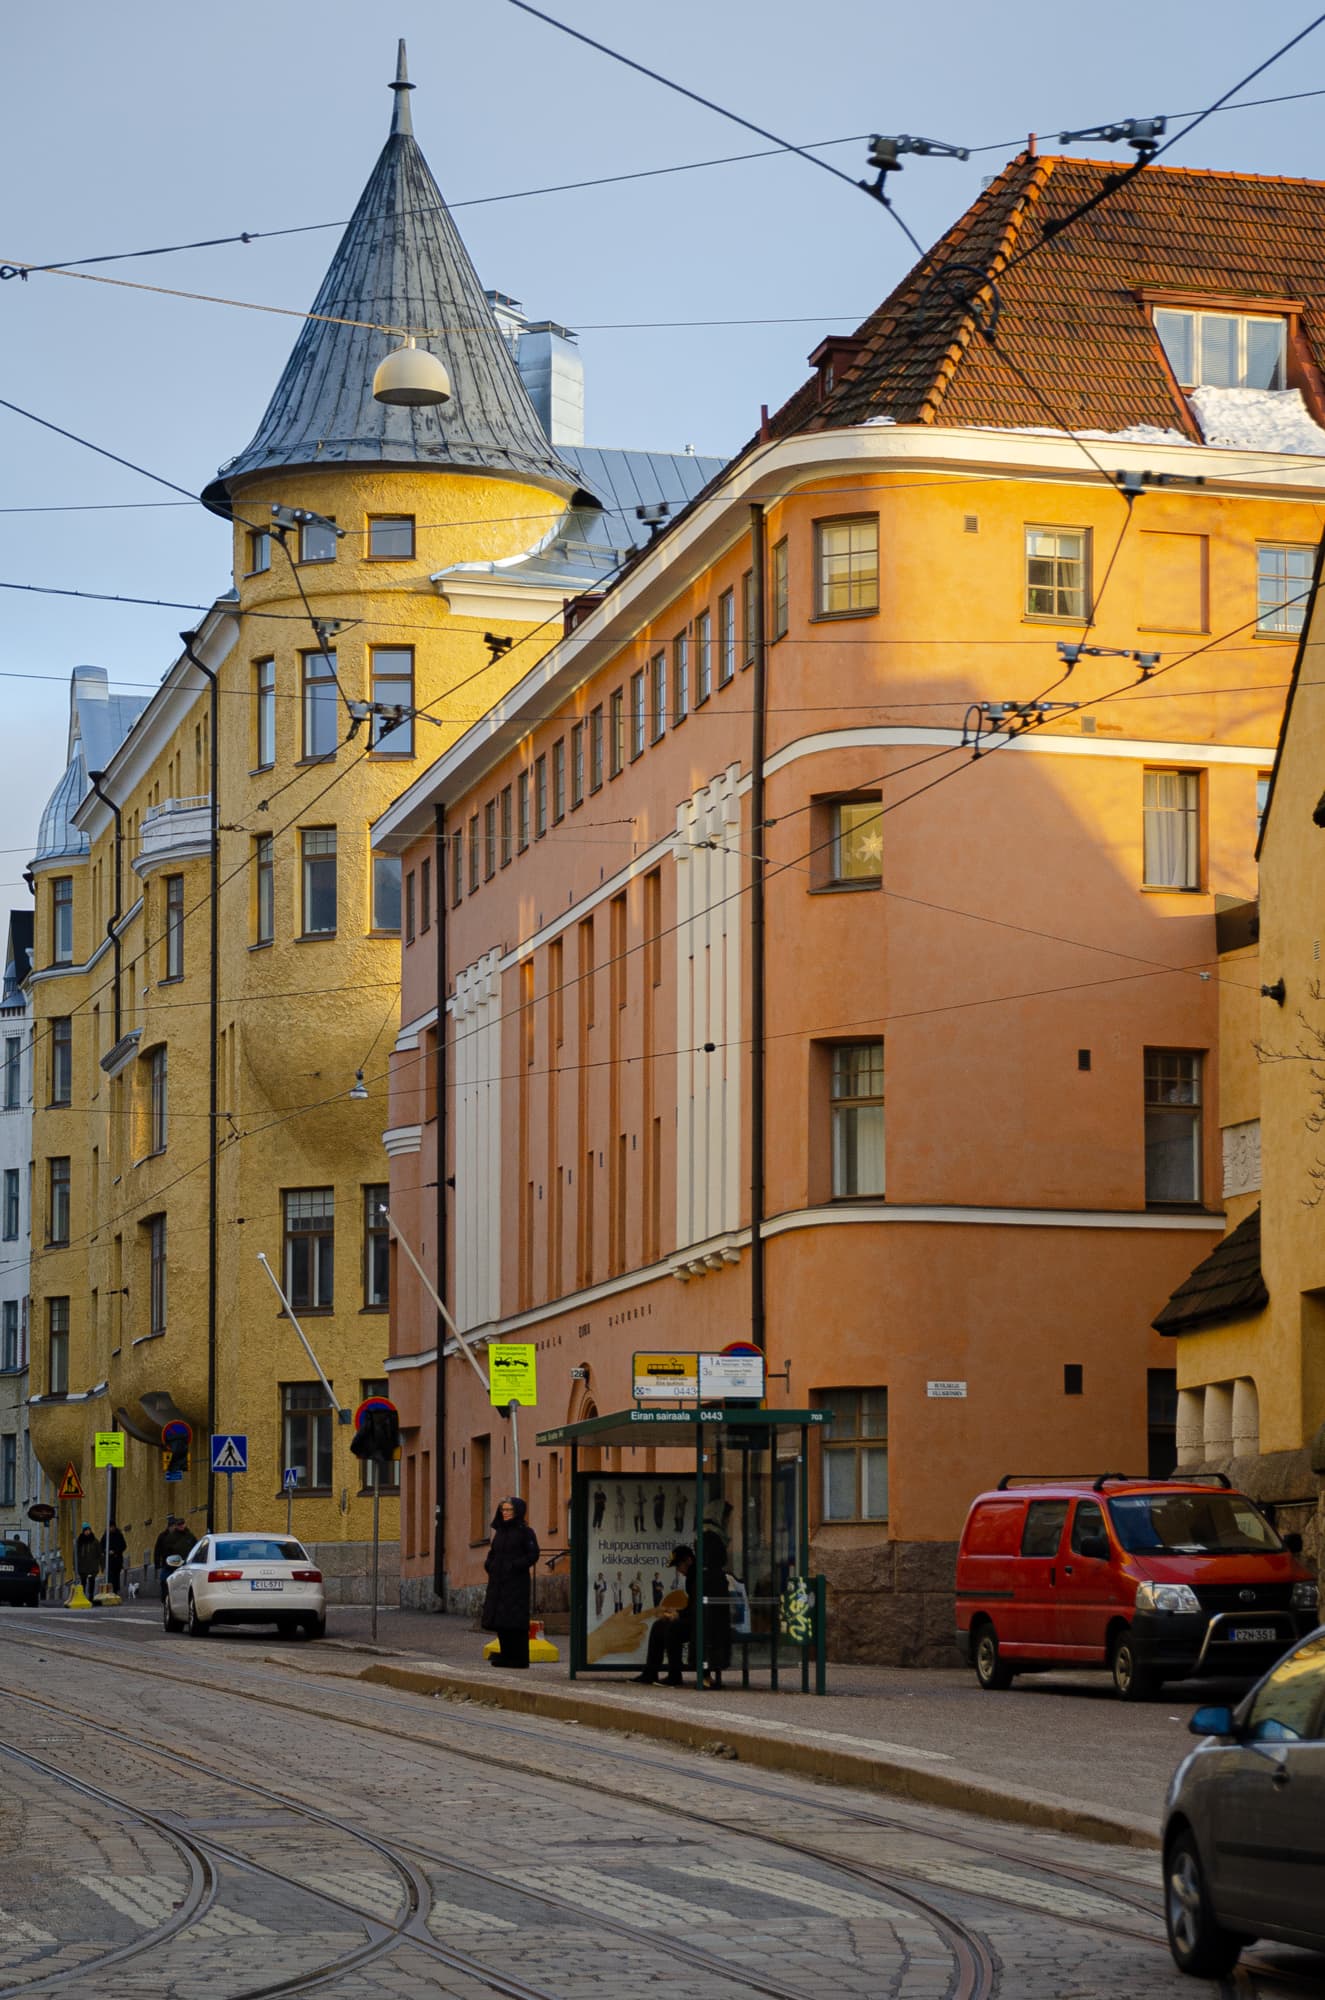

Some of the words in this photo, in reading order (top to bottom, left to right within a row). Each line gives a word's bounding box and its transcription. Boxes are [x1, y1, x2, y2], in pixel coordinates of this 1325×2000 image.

[674, 1387, 697, 1396] 0443
[631, 1411, 654, 1421] Eiran
[656, 1411, 691, 1421] sairaala
[700, 1411, 723, 1421] 0443
